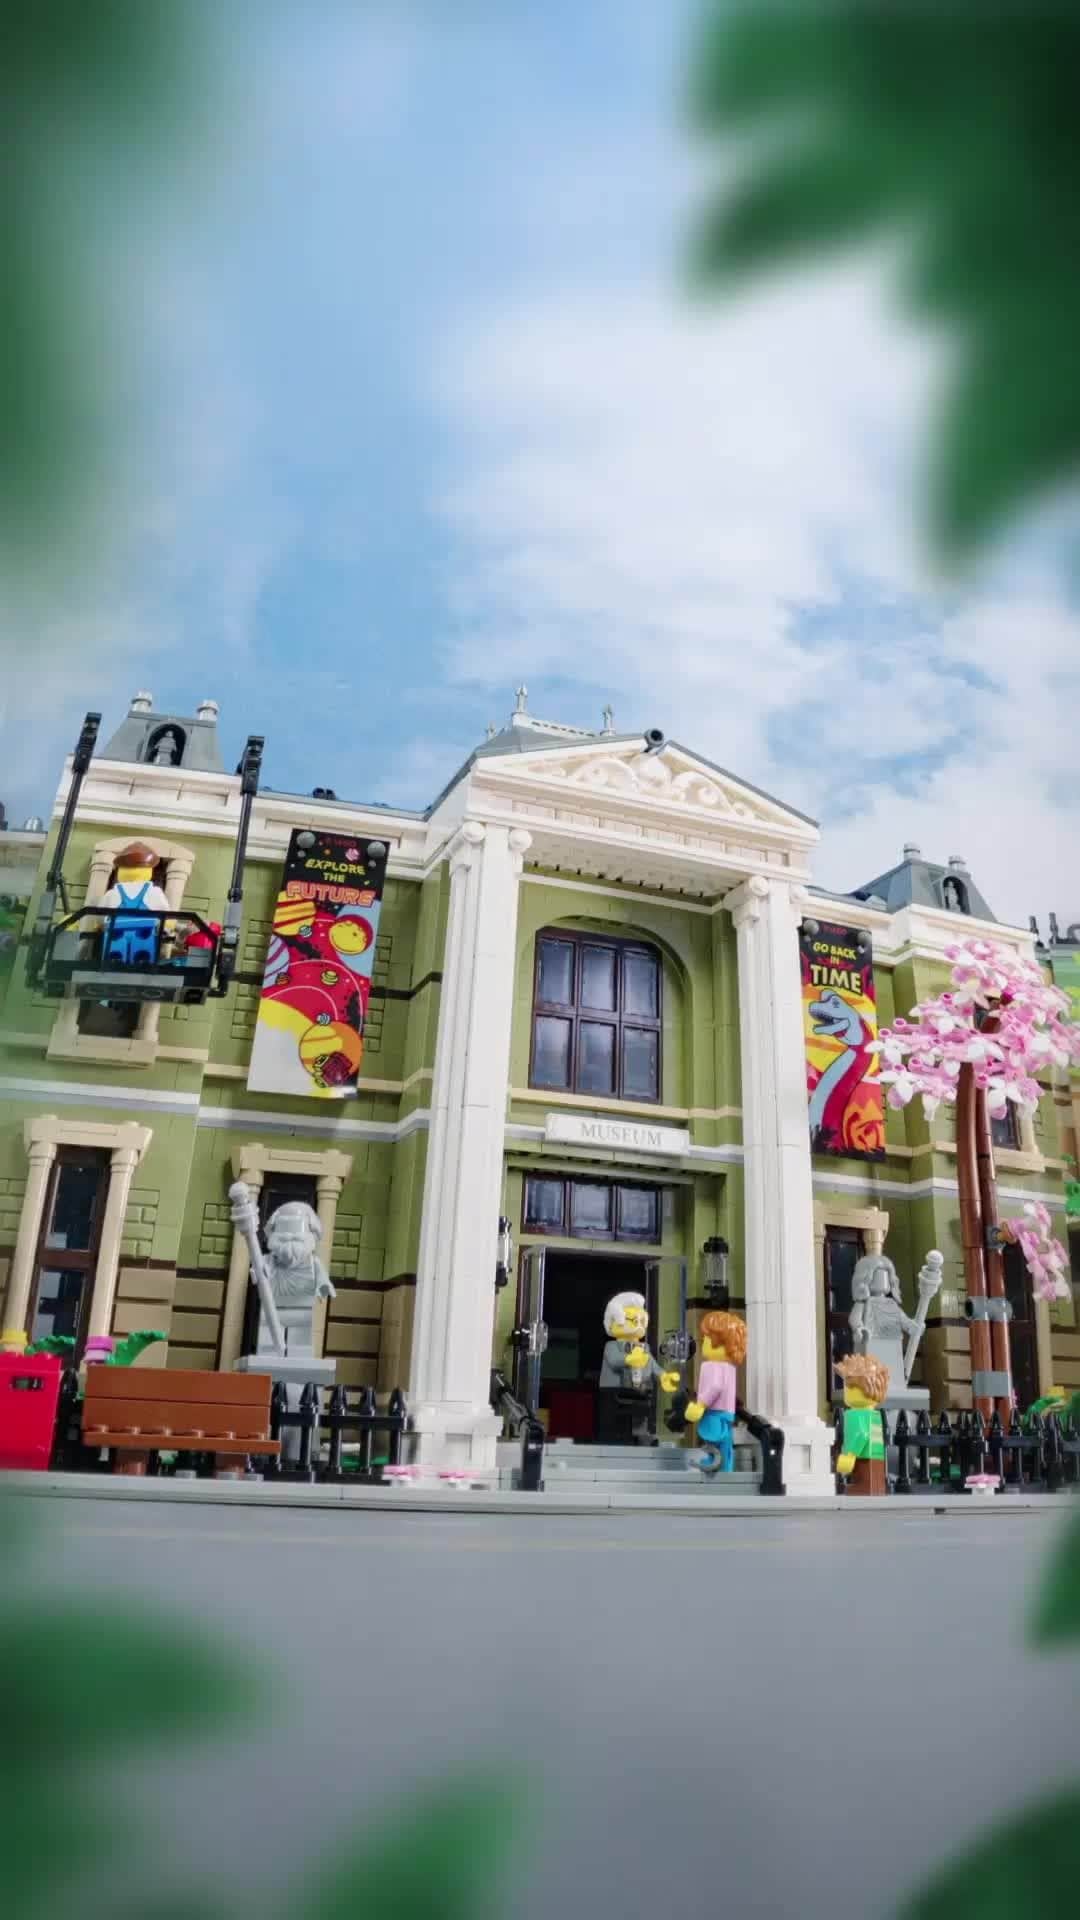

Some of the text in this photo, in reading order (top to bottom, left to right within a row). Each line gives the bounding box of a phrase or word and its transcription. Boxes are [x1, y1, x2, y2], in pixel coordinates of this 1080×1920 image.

[305, 859, 366, 876] EXPLORE
[323, 872, 345, 883] THE
[287, 880, 377, 908] FUTURE
[813, 942, 857, 960] GO BACK
[831, 956, 840, 965] IN
[810, 964, 862, 994] TIME
[580, 1121, 663, 1147] MUSEUM
